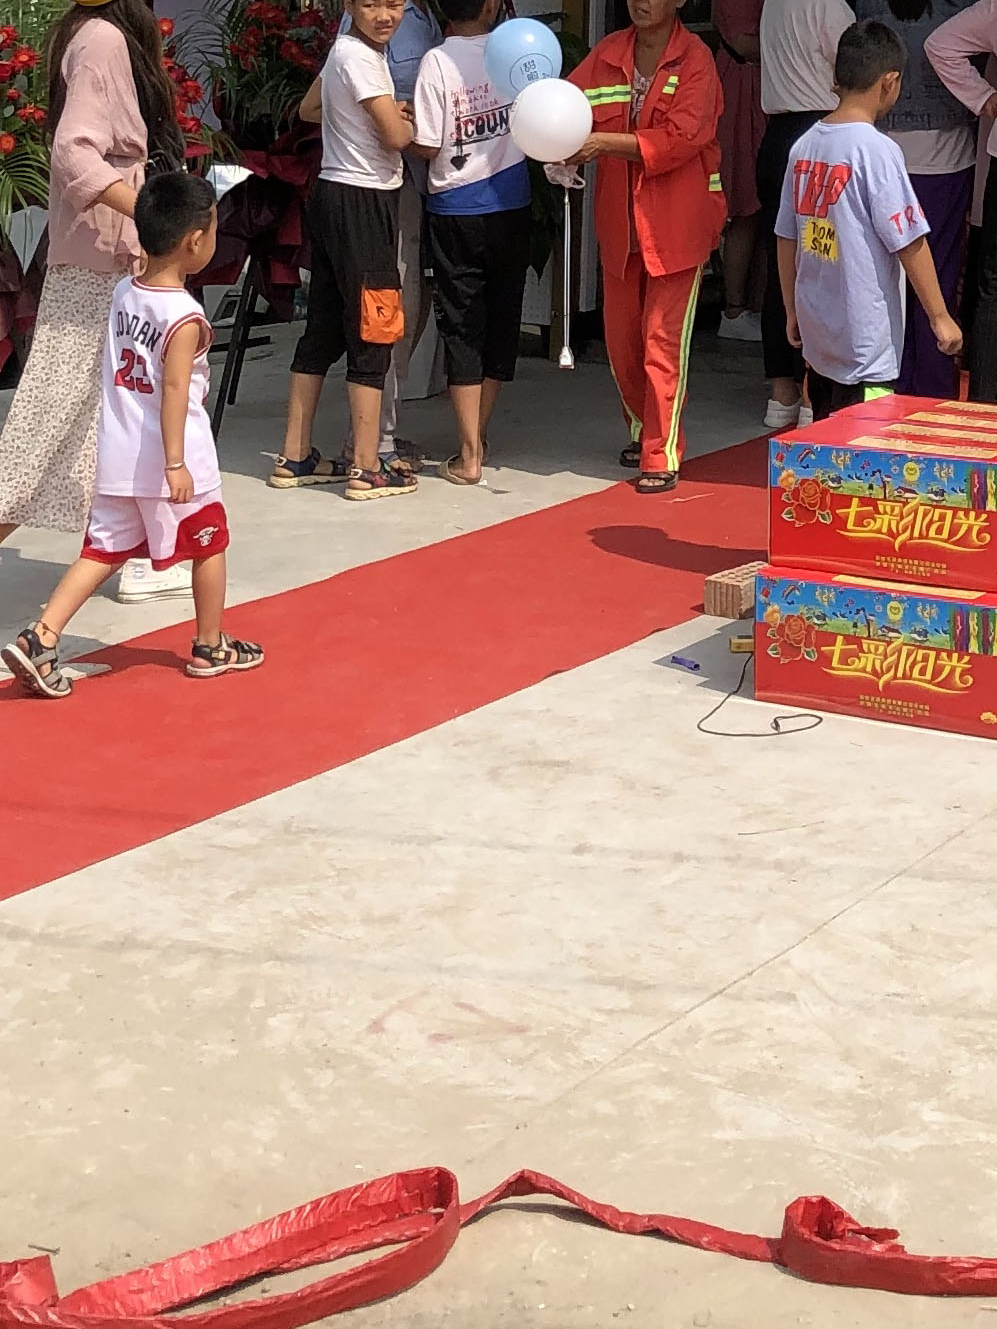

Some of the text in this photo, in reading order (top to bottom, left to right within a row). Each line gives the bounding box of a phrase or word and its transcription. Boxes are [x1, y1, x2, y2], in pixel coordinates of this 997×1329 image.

[115, 348, 154, 394] 23
[836, 497, 991, 552] 七彩阳光
[821, 635, 974, 693] 七彩阳光
